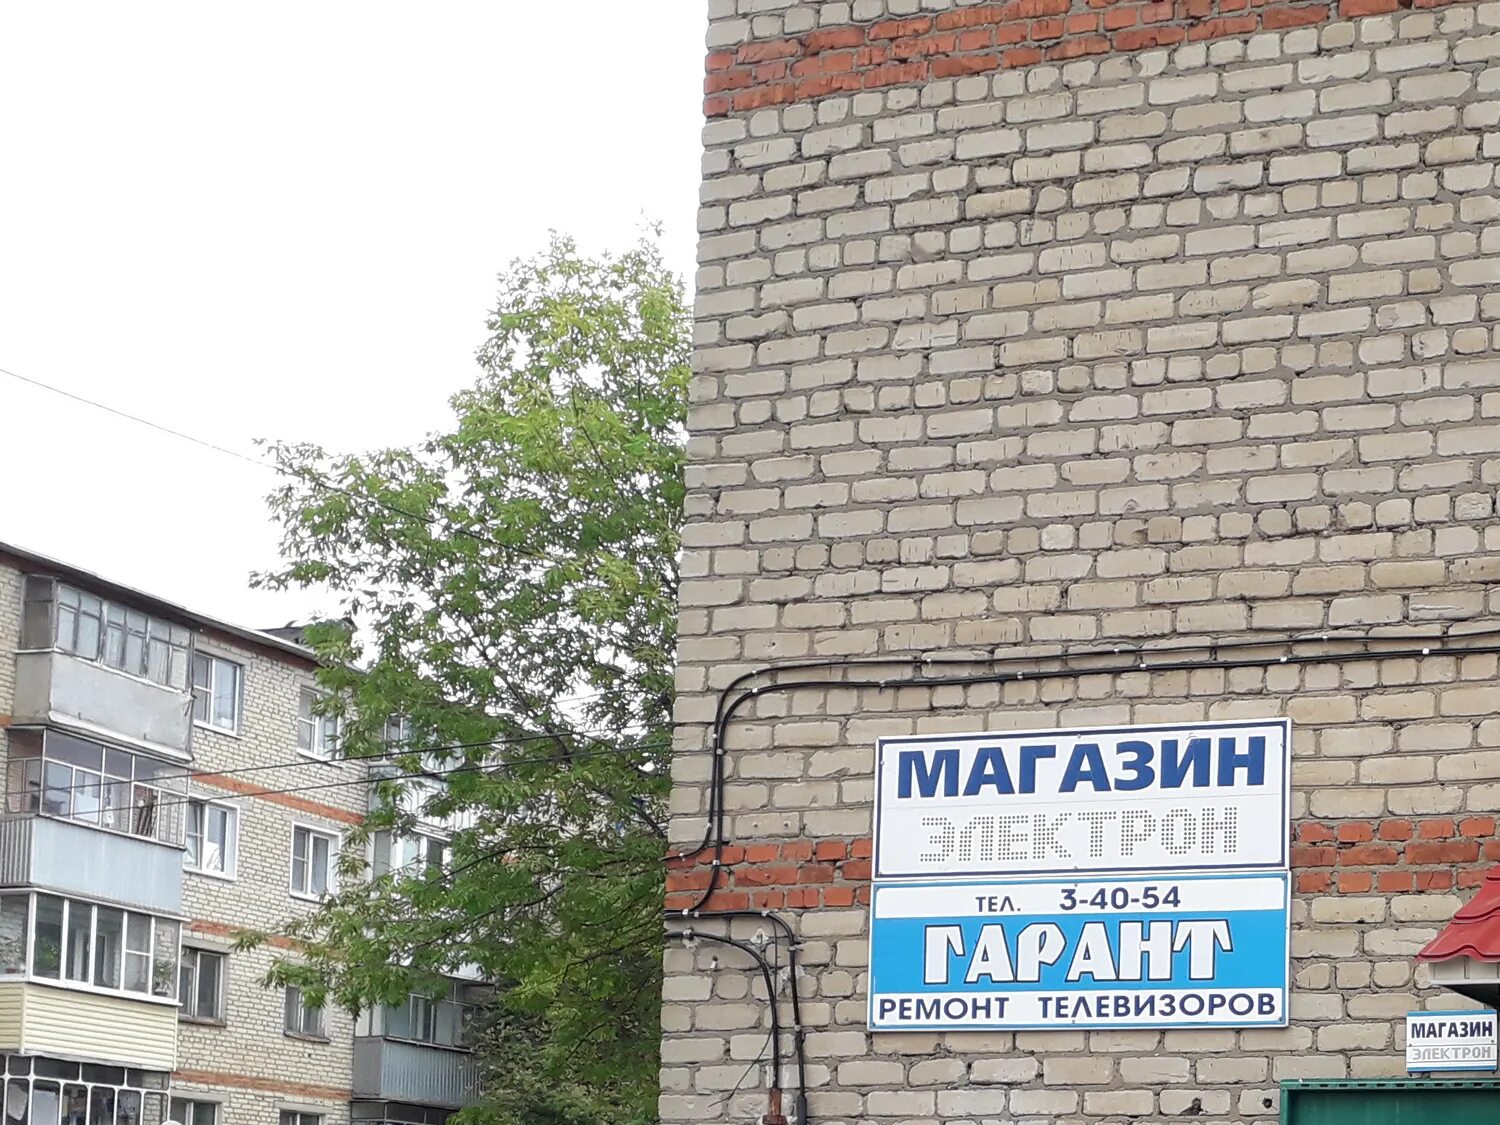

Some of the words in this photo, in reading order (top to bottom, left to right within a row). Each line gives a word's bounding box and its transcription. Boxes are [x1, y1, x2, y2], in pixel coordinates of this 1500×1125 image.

[897, 735, 1267, 799] МАГАЗИН
[919, 806, 1239, 863] ЭЛЕКТРОН
[975, 895, 1022, 913] ТЕЛ.
[1058, 885, 1181, 912] 3-40-54
[922, 918, 1234, 985] ГАРАНТ
[878, 996, 1010, 1020] РЕМОНТ
[1037, 992, 1276, 1019] ТЕЛЕВИЗОРОВ
[1411, 1021, 1493, 1038] МАГАЗИН
[1412, 1046, 1491, 1060] ЭЛЕКТРОН
